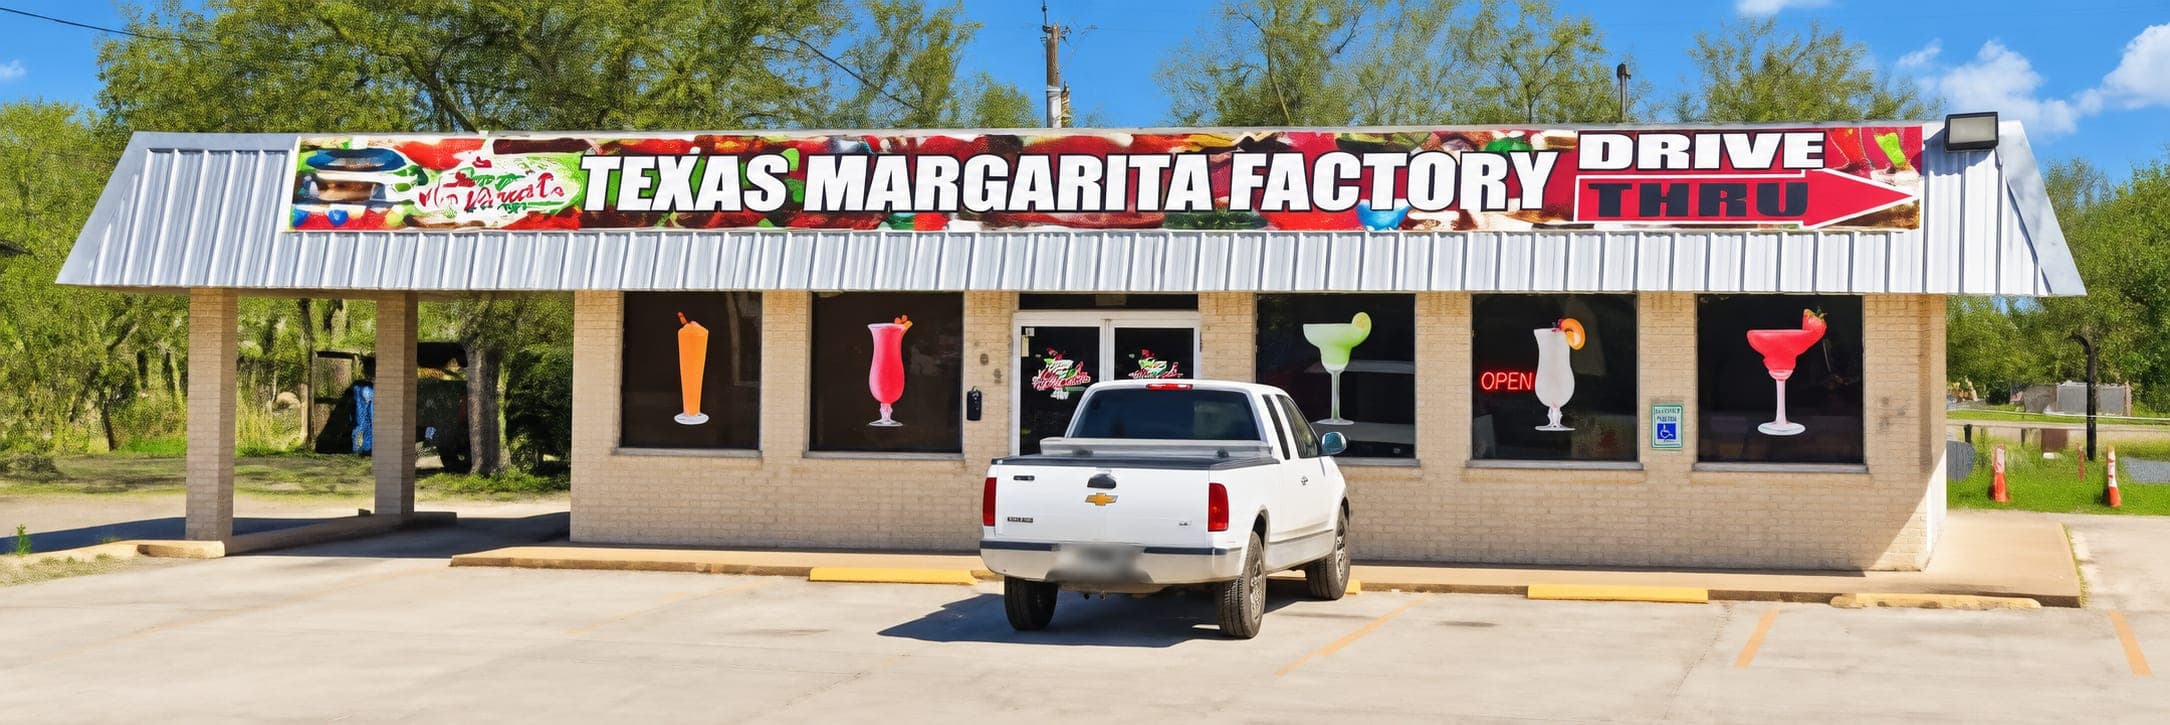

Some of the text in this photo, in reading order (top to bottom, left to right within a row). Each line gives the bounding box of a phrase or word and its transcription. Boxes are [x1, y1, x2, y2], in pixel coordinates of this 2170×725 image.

[1578, 131, 1824, 169] DRIVE
[583, 153, 787, 212] TEXAS
[805, 152, 1212, 212] MARGARITA
[1230, 150, 1556, 212] FACTORY
[1588, 182, 1808, 217] THRU
[1481, 371, 1532, 391] OPEN
